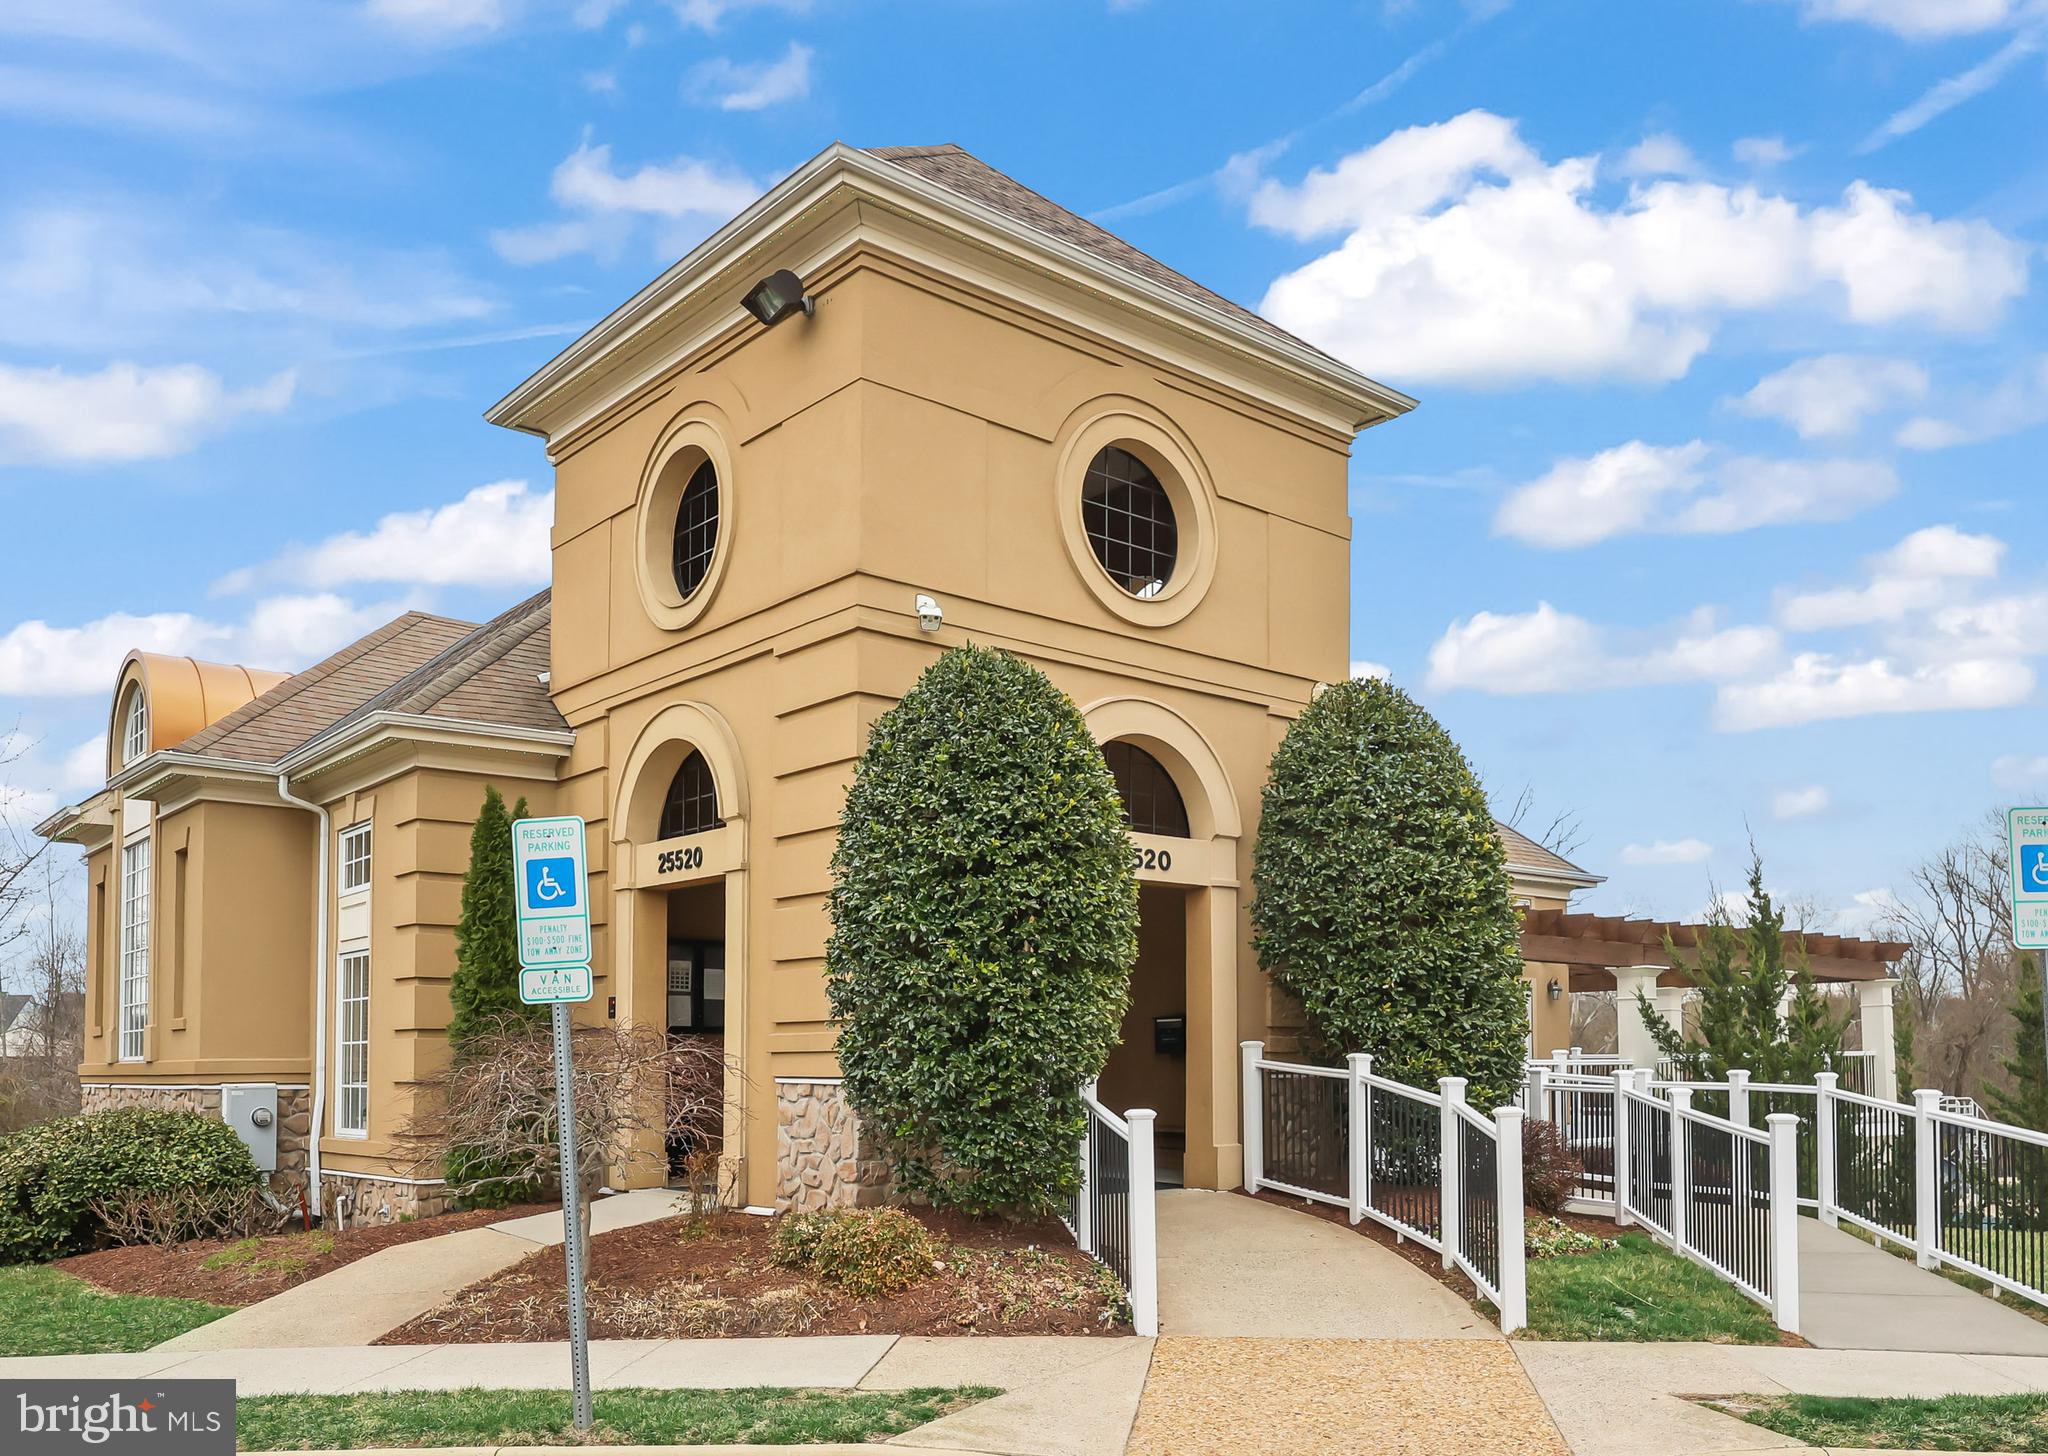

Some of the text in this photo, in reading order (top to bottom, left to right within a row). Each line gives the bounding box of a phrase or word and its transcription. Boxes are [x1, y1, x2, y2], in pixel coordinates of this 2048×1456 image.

[522, 827, 575, 839] RESERVED
[528, 840, 571, 852] PARKING
[657, 846, 703, 874] 25520
[539, 924, 567, 934] PENALTY
[527, 934, 582, 946] $100-$500 FINE
[527, 945, 582, 957] TOW AWAY ZONE
[539, 974, 571, 985] VAN
[531, 985, 581, 995] ACCESSIBLE
